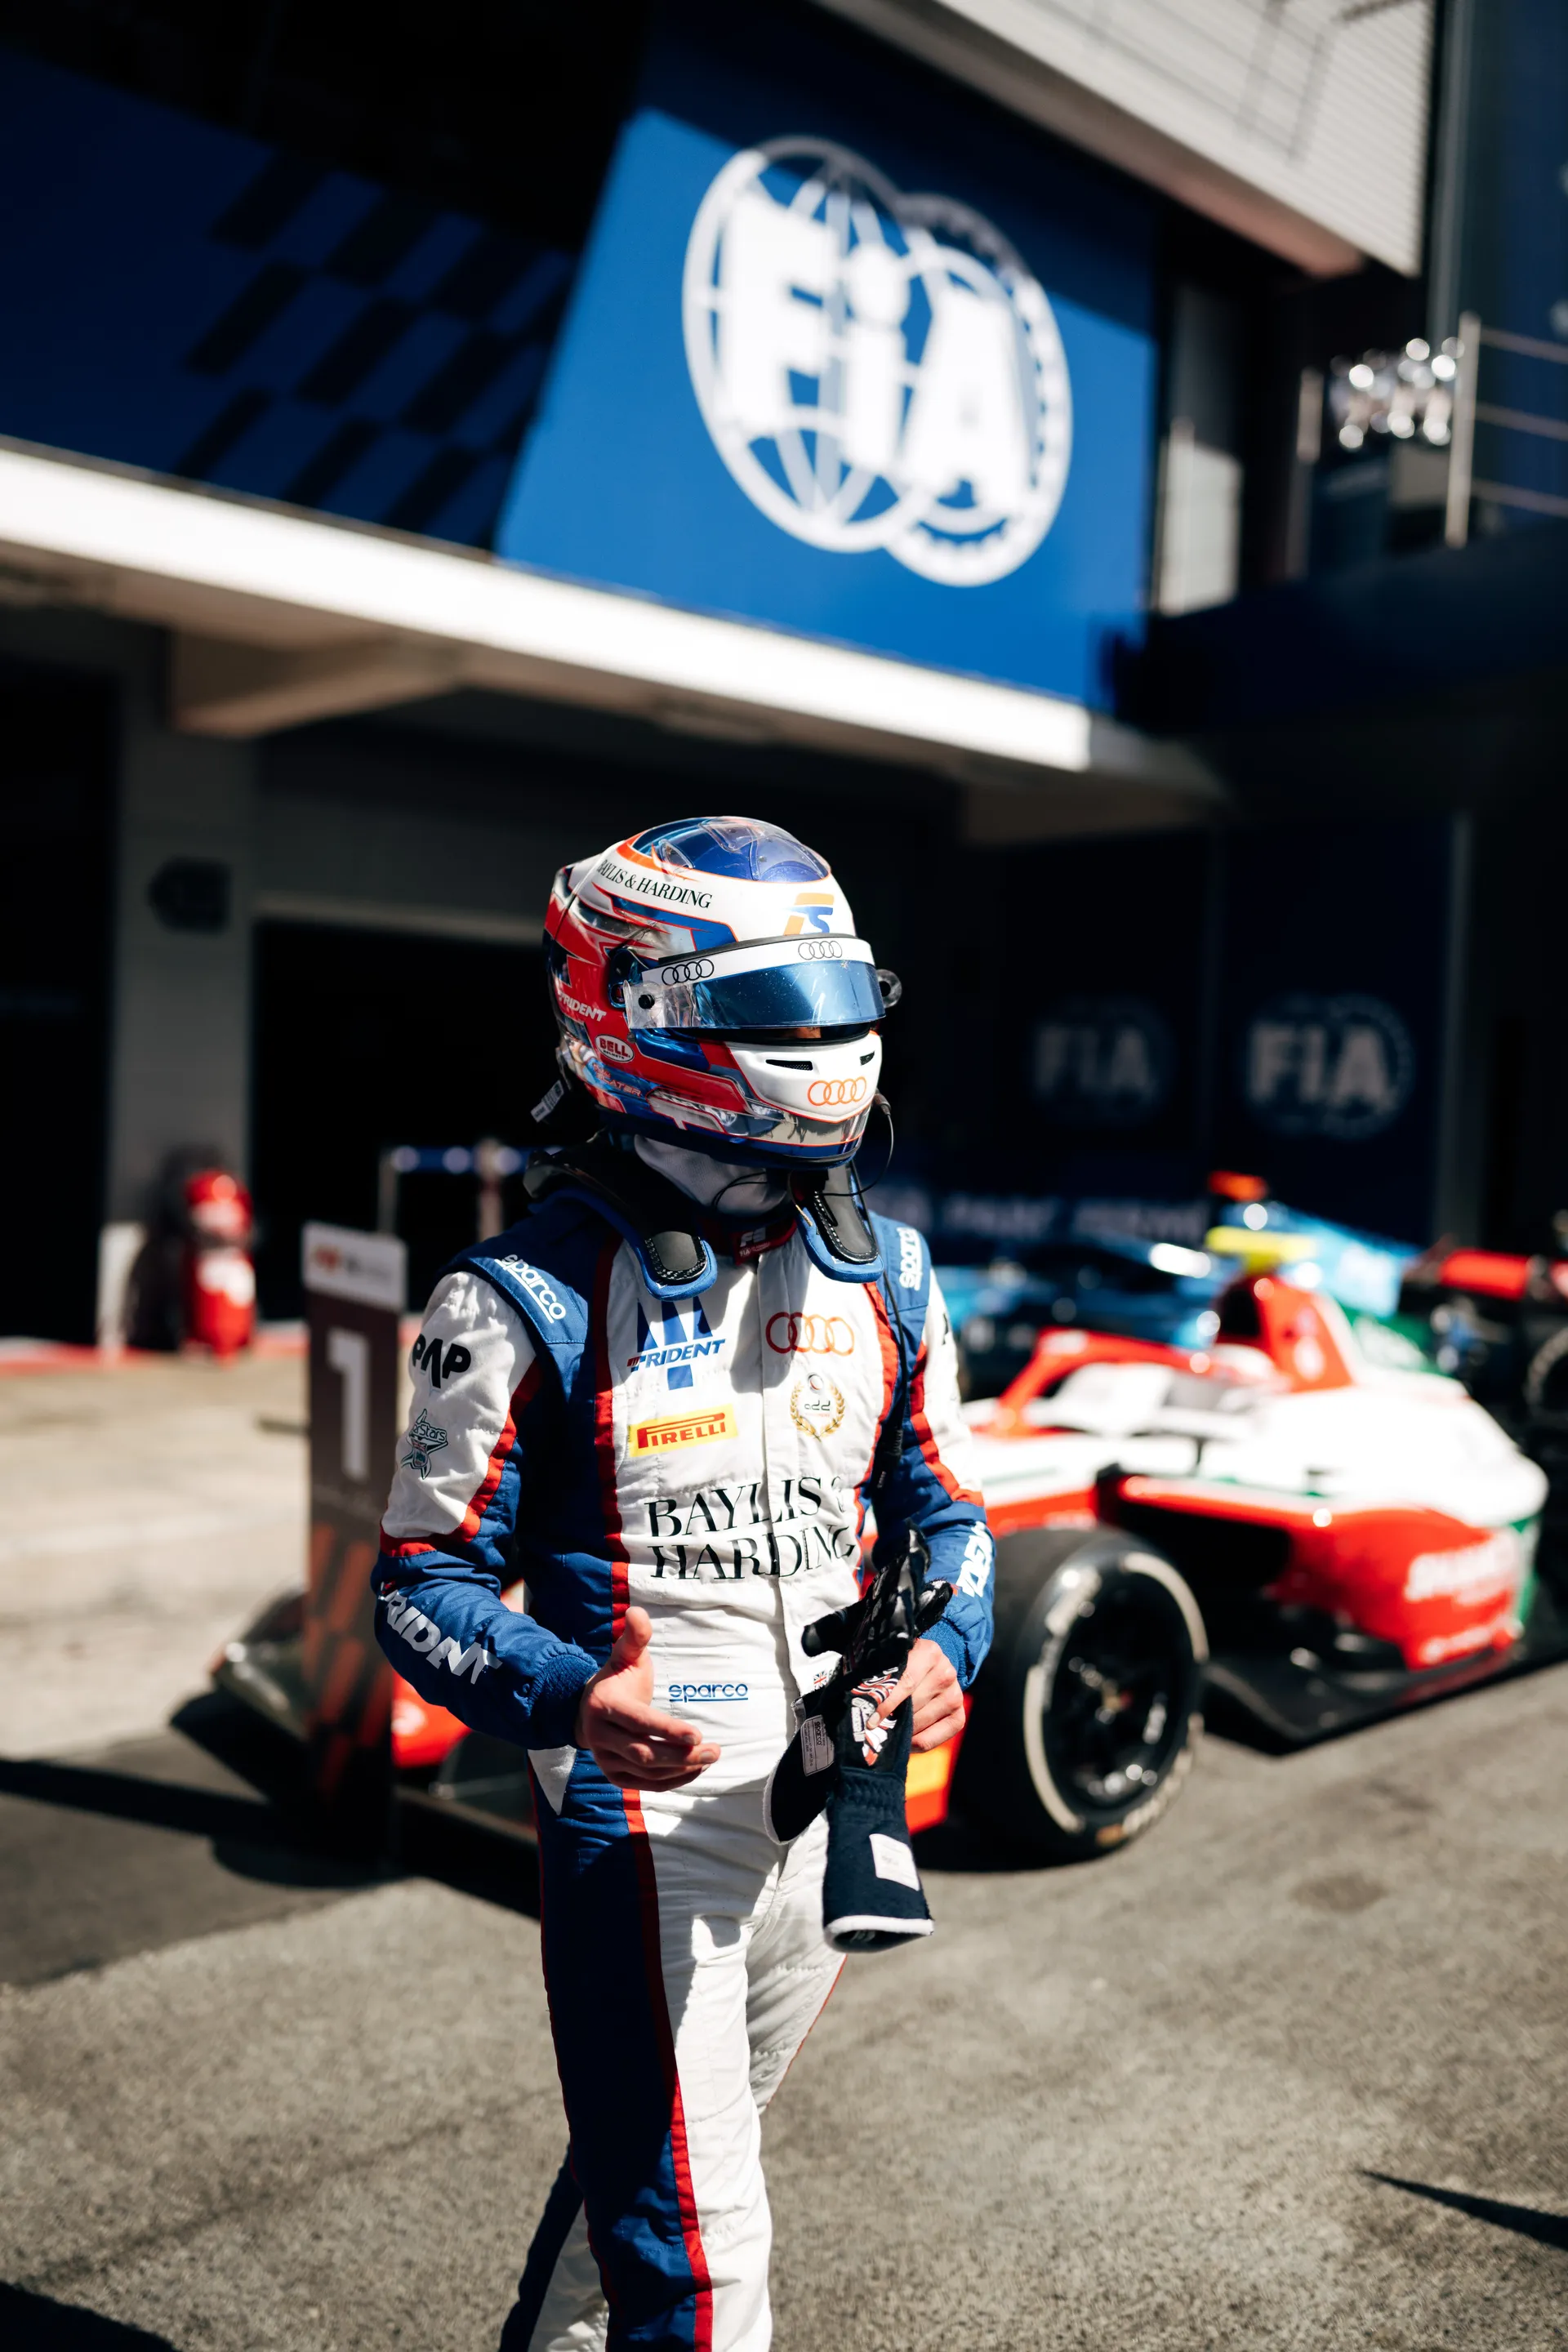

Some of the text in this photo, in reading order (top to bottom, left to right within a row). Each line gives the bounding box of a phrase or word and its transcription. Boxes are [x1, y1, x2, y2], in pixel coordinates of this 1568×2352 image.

[625, 874, 636, 889] &
[636, 878, 713, 909] HARDING
[558, 991, 607, 1022] TRIDENT
[599, 1037, 630, 1058] BELL
[495, 1254, 566, 1324] sparco
[627, 1339, 726, 1373] TRIDENT
[330, 1327, 371, 1482] 1
[637, 1412, 726, 1449] PIRELLI
[644, 1476, 822, 1538] BAYLIS
[647, 1523, 857, 1580] HARDING
[668, 1683, 749, 1703] sparco
[814, 1721, 822, 1746] sparco
